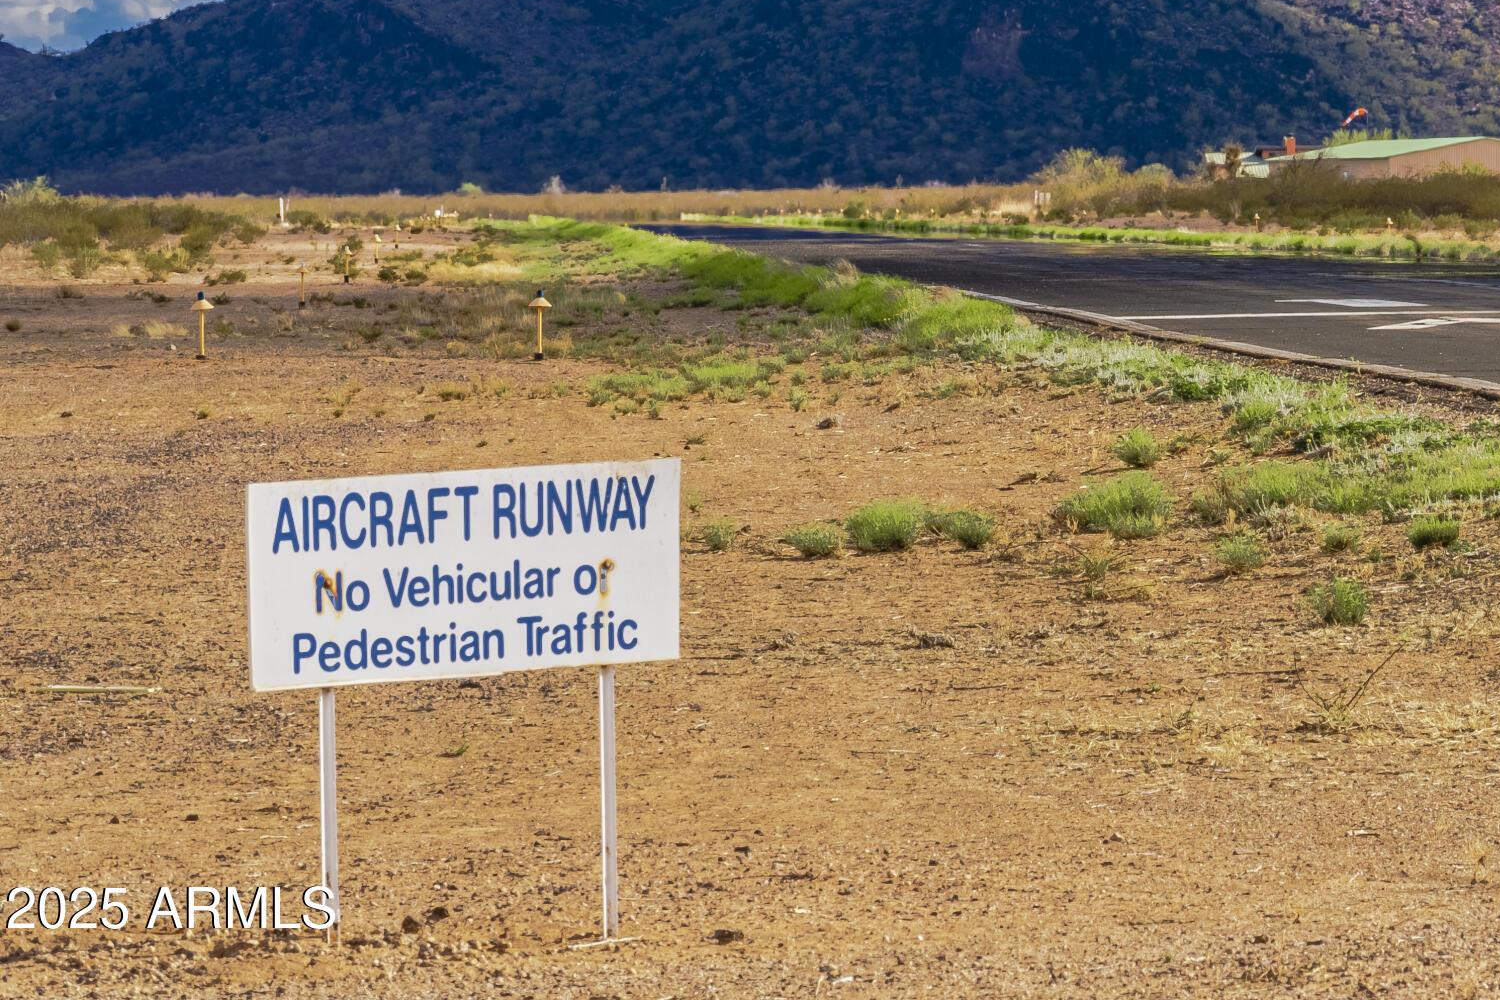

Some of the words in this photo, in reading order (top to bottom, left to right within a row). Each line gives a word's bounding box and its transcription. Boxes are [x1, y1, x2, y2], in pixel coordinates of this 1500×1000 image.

[272, 486, 479, 554] AIRCRAFT
[493, 474, 655, 539] RUNWAY
[314, 570, 370, 614] No
[383, 559, 561, 608] Vehicular
[573, 559, 614, 595] or
[293, 622, 504, 674] Pedestrian
[517, 611, 638, 657] Traffic
